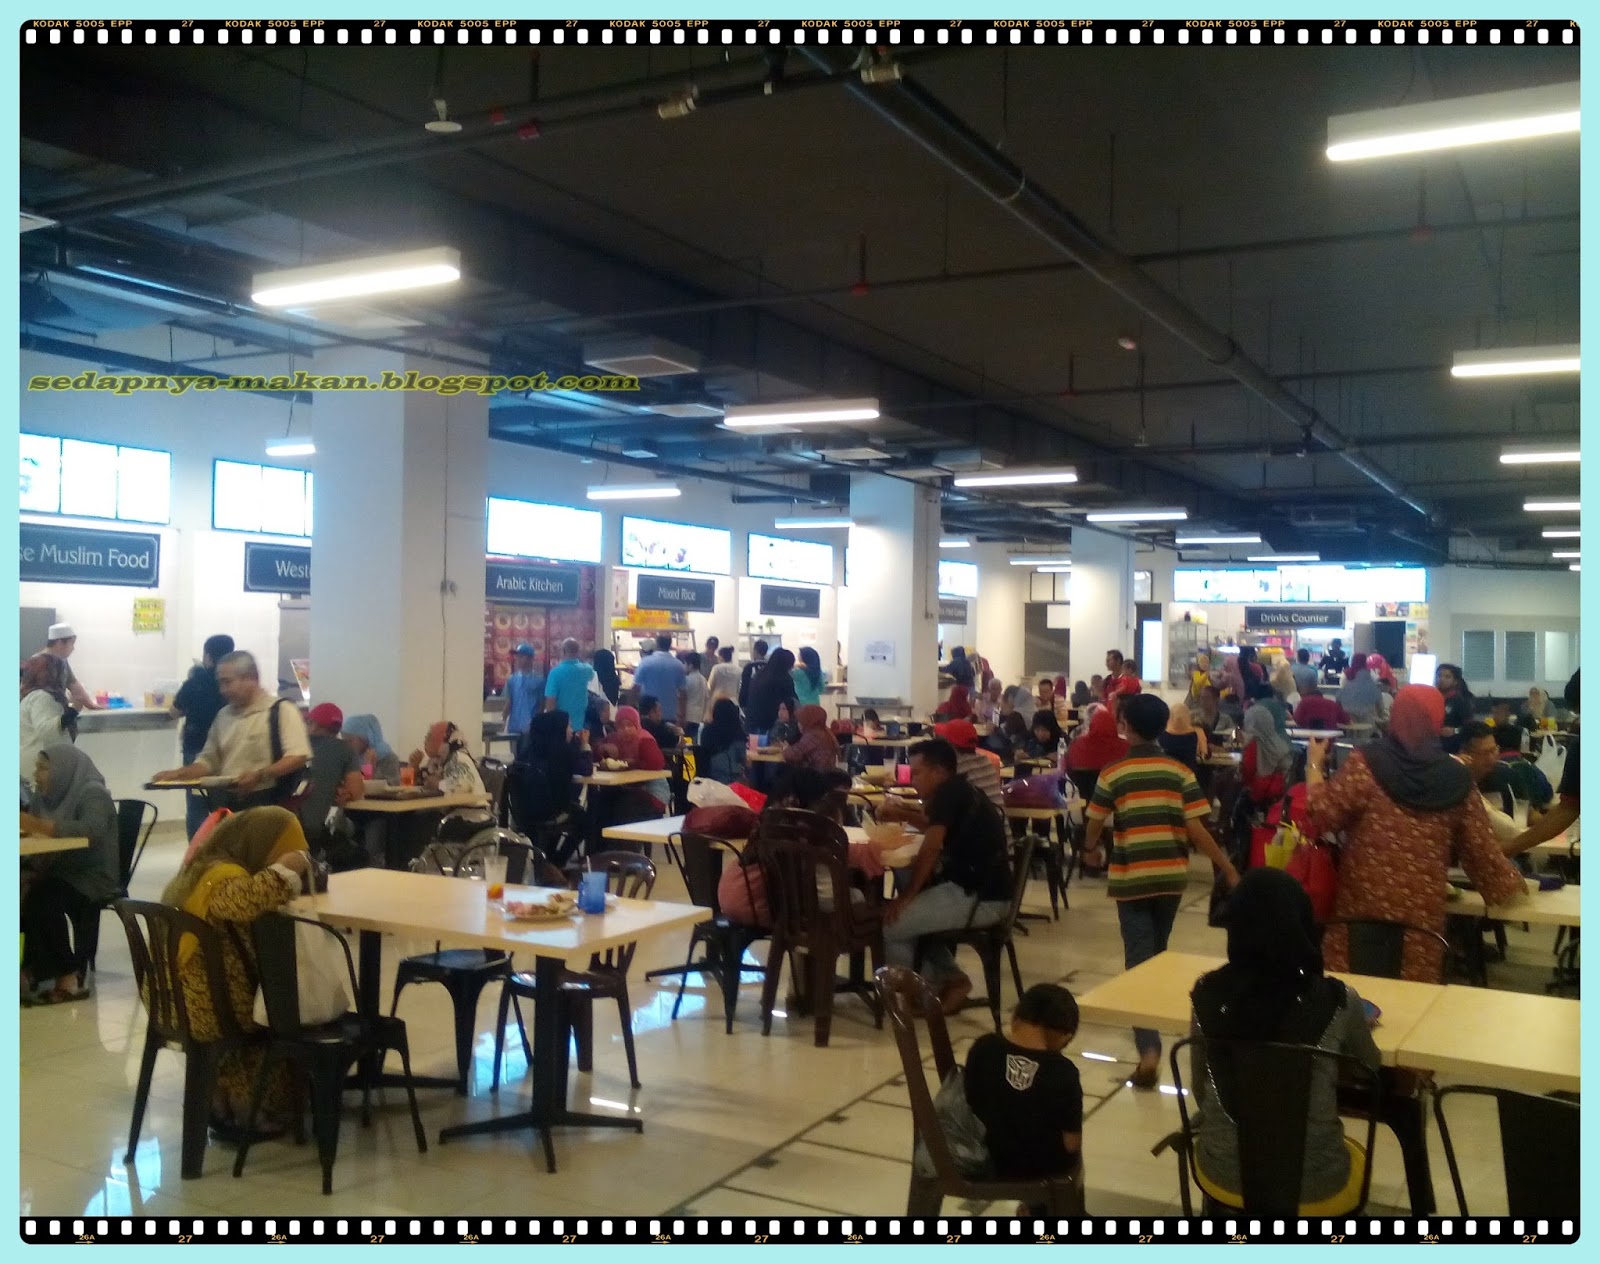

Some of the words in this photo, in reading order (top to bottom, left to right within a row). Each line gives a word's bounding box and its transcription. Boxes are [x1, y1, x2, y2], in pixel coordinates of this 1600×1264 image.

[40, 543, 103, 566] Muslim
[108, 548, 150, 569] Food
[274, 559, 311, 579] West
[496, 574, 527, 591] Arabic
[529, 577, 564, 593] Kitchen
[658, 586, 680, 600] Mixed
[681, 588, 697, 601] Rice
[1260, 613, 1289, 623] Drinks
[1291, 613, 1329, 623] Counter
